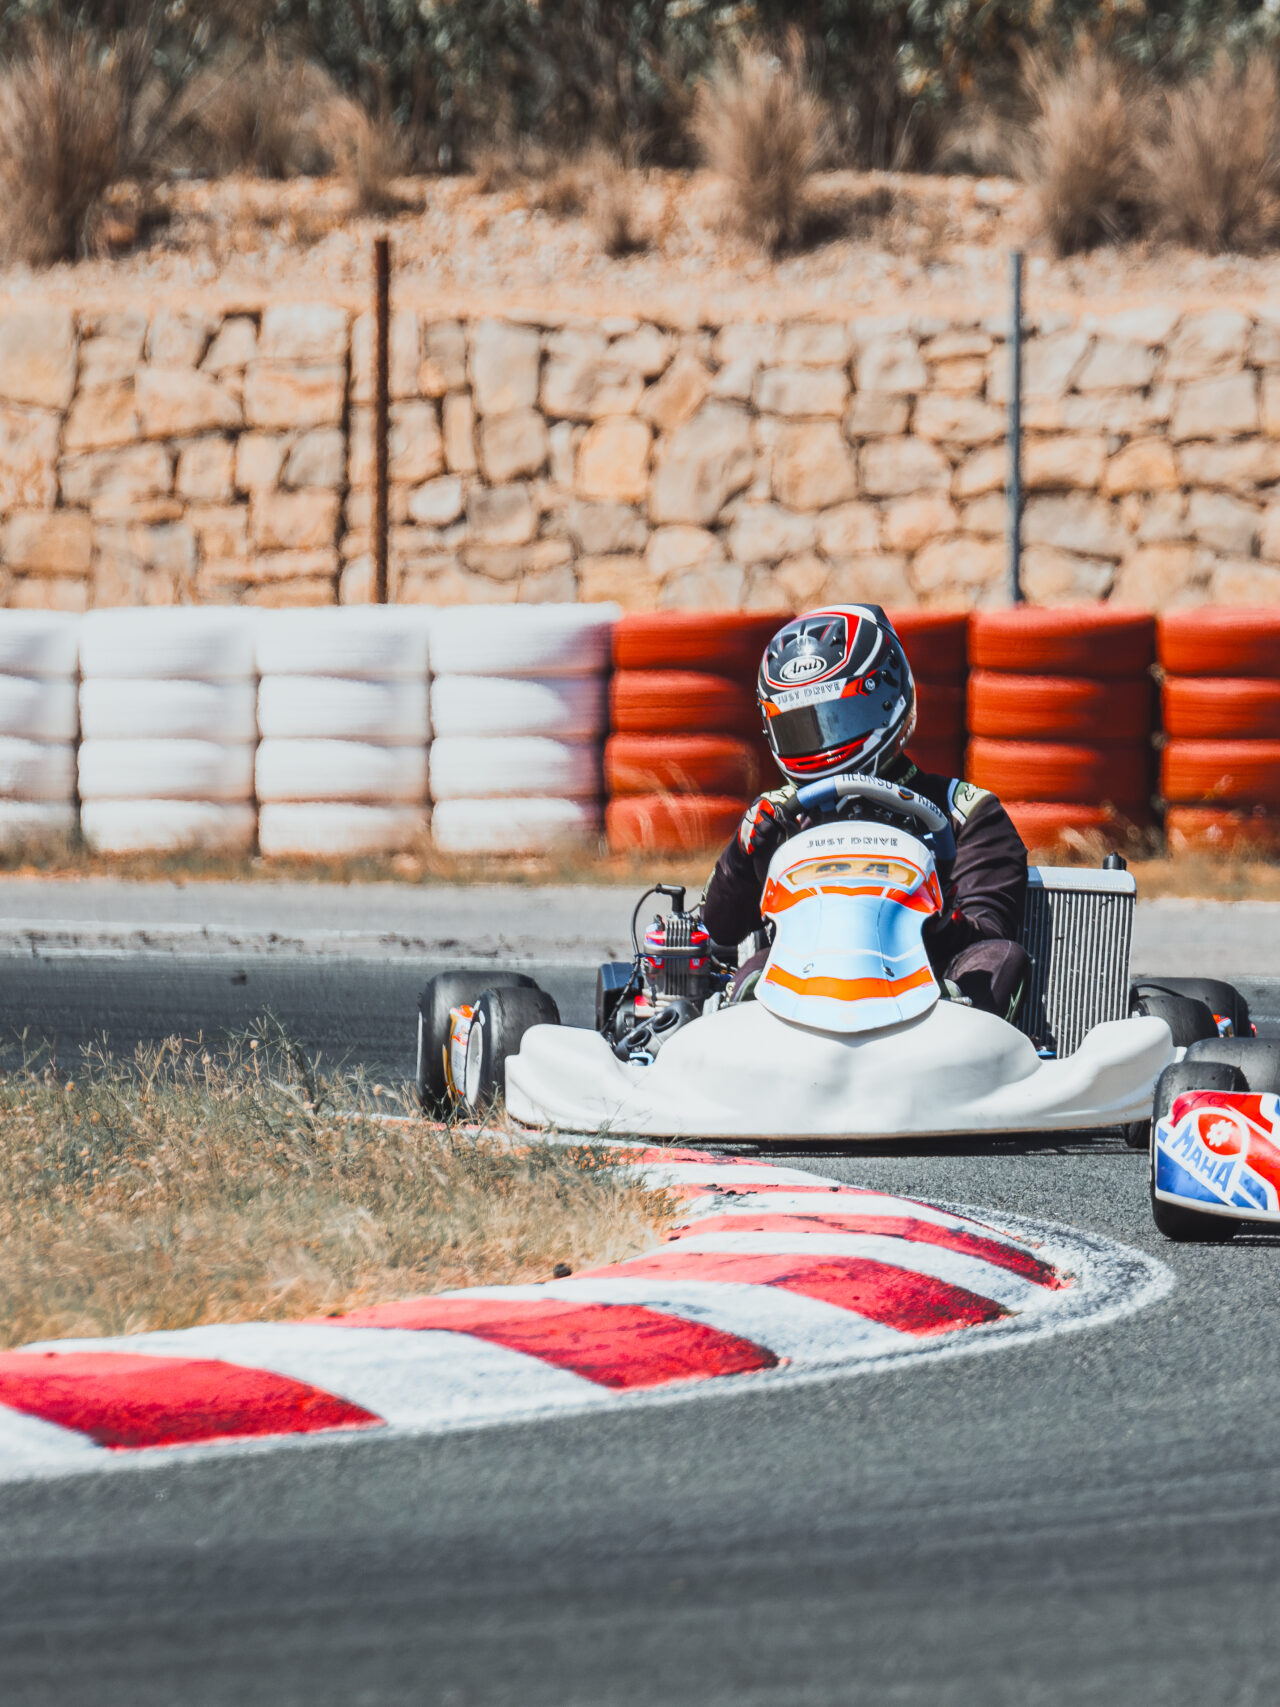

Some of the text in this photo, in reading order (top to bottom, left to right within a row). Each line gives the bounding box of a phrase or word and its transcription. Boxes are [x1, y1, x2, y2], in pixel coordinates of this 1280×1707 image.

[777, 690, 800, 705] JUST
[804, 681, 841, 697] DRIVE
[807, 836, 898, 848] JUST DRIVE
[1171, 1122, 1236, 1192] MAHA
